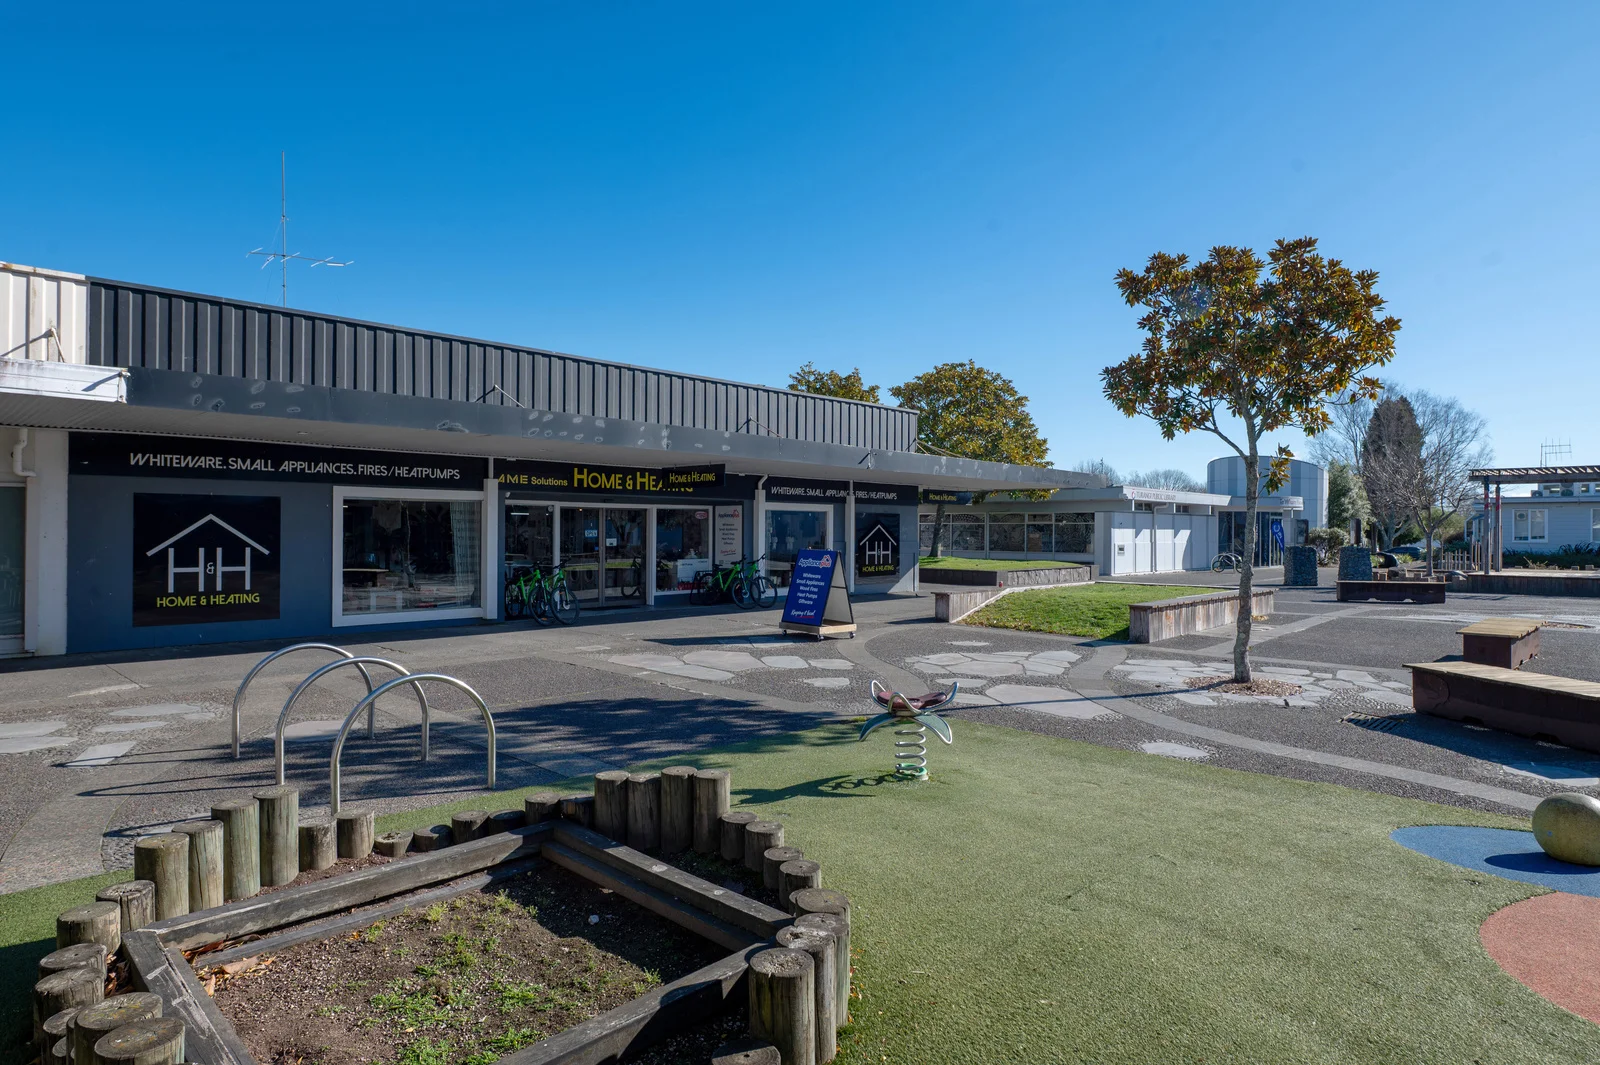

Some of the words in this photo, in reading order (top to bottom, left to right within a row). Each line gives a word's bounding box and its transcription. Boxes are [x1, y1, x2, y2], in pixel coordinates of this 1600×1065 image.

[228, 457, 275, 472] SMALL
[531, 476, 568, 487] Solutions
[573, 467, 623, 490] HOME
[625, 475, 633, 490] &
[669, 472, 687, 483] HOME
[691, 471, 716, 483] HEATING
[806, 488, 824, 497] SMALL
[156, 596, 197, 608] HOME
[200, 596, 207, 606] &
[210, 593, 261, 605] HEATING
